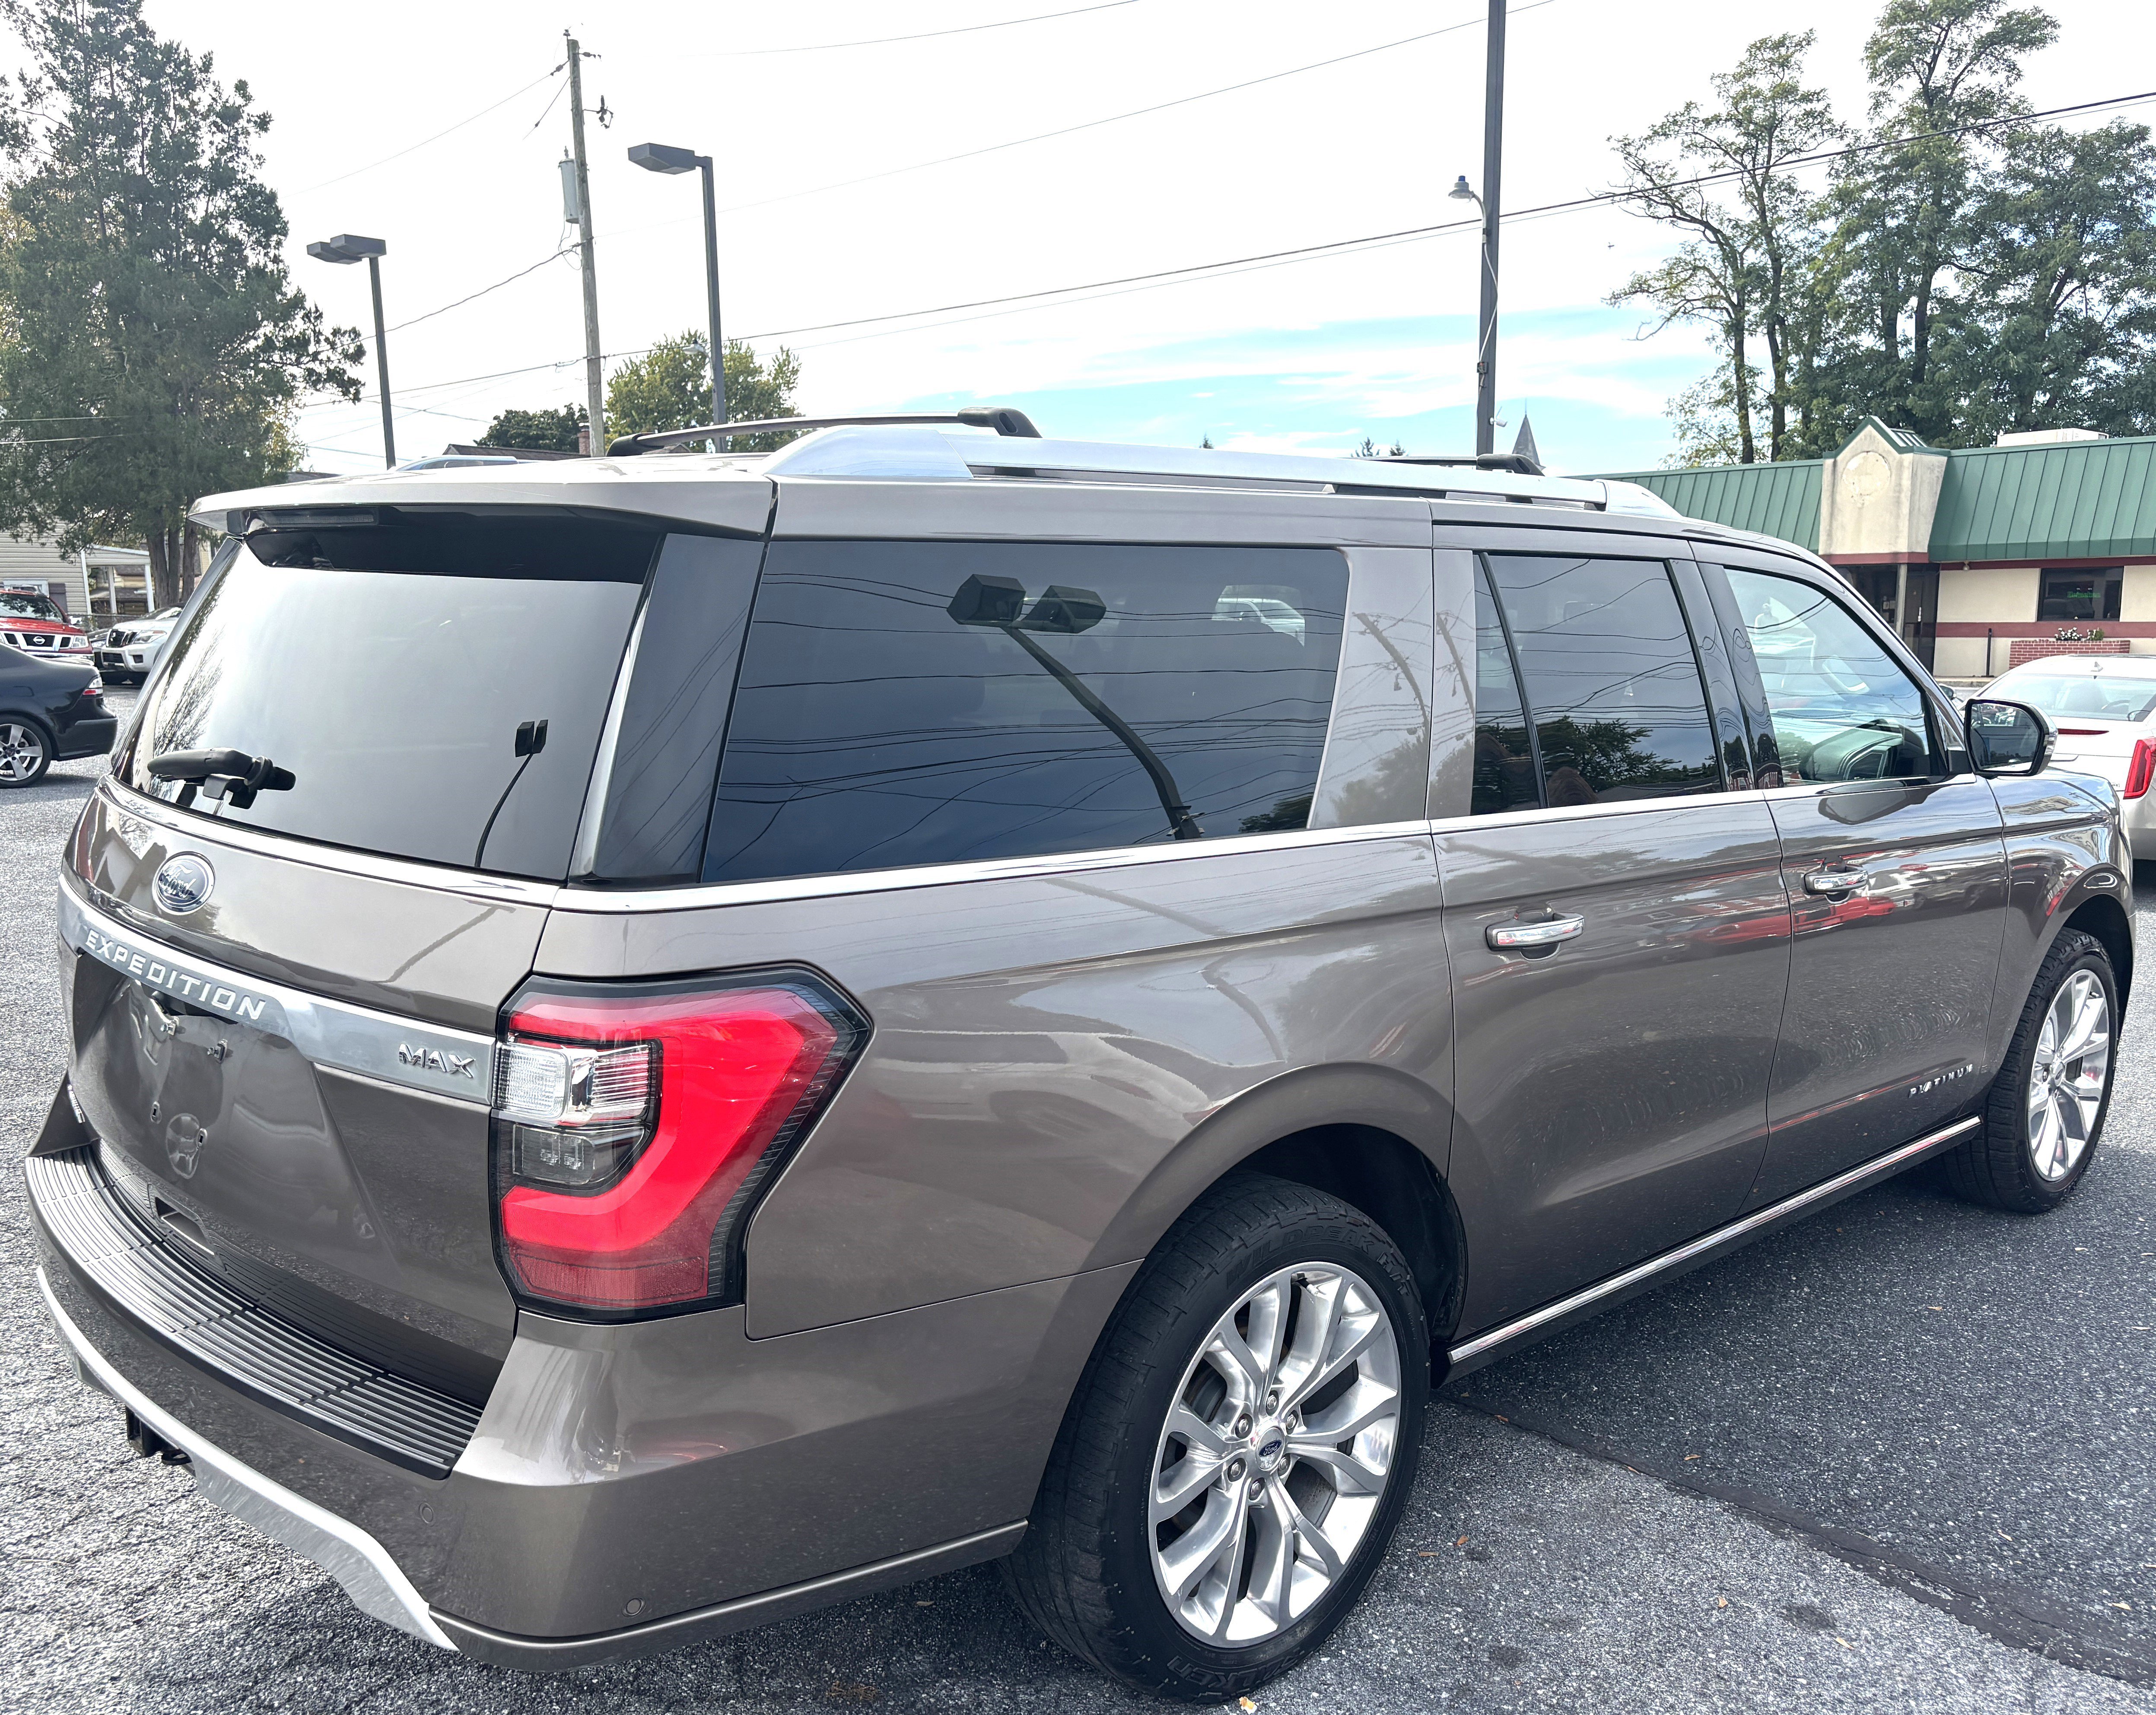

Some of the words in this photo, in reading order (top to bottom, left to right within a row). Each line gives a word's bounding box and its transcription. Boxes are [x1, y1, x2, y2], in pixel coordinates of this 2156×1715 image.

[85, 929, 267, 1020] EXPEDITION
[399, 1044, 476, 1078] MAX
[1908, 1064, 1973, 1098] PLATINUM
[1226, 1225, 1375, 1289] WILDPEAK
[1263, 1442, 1278, 1456] Ford
